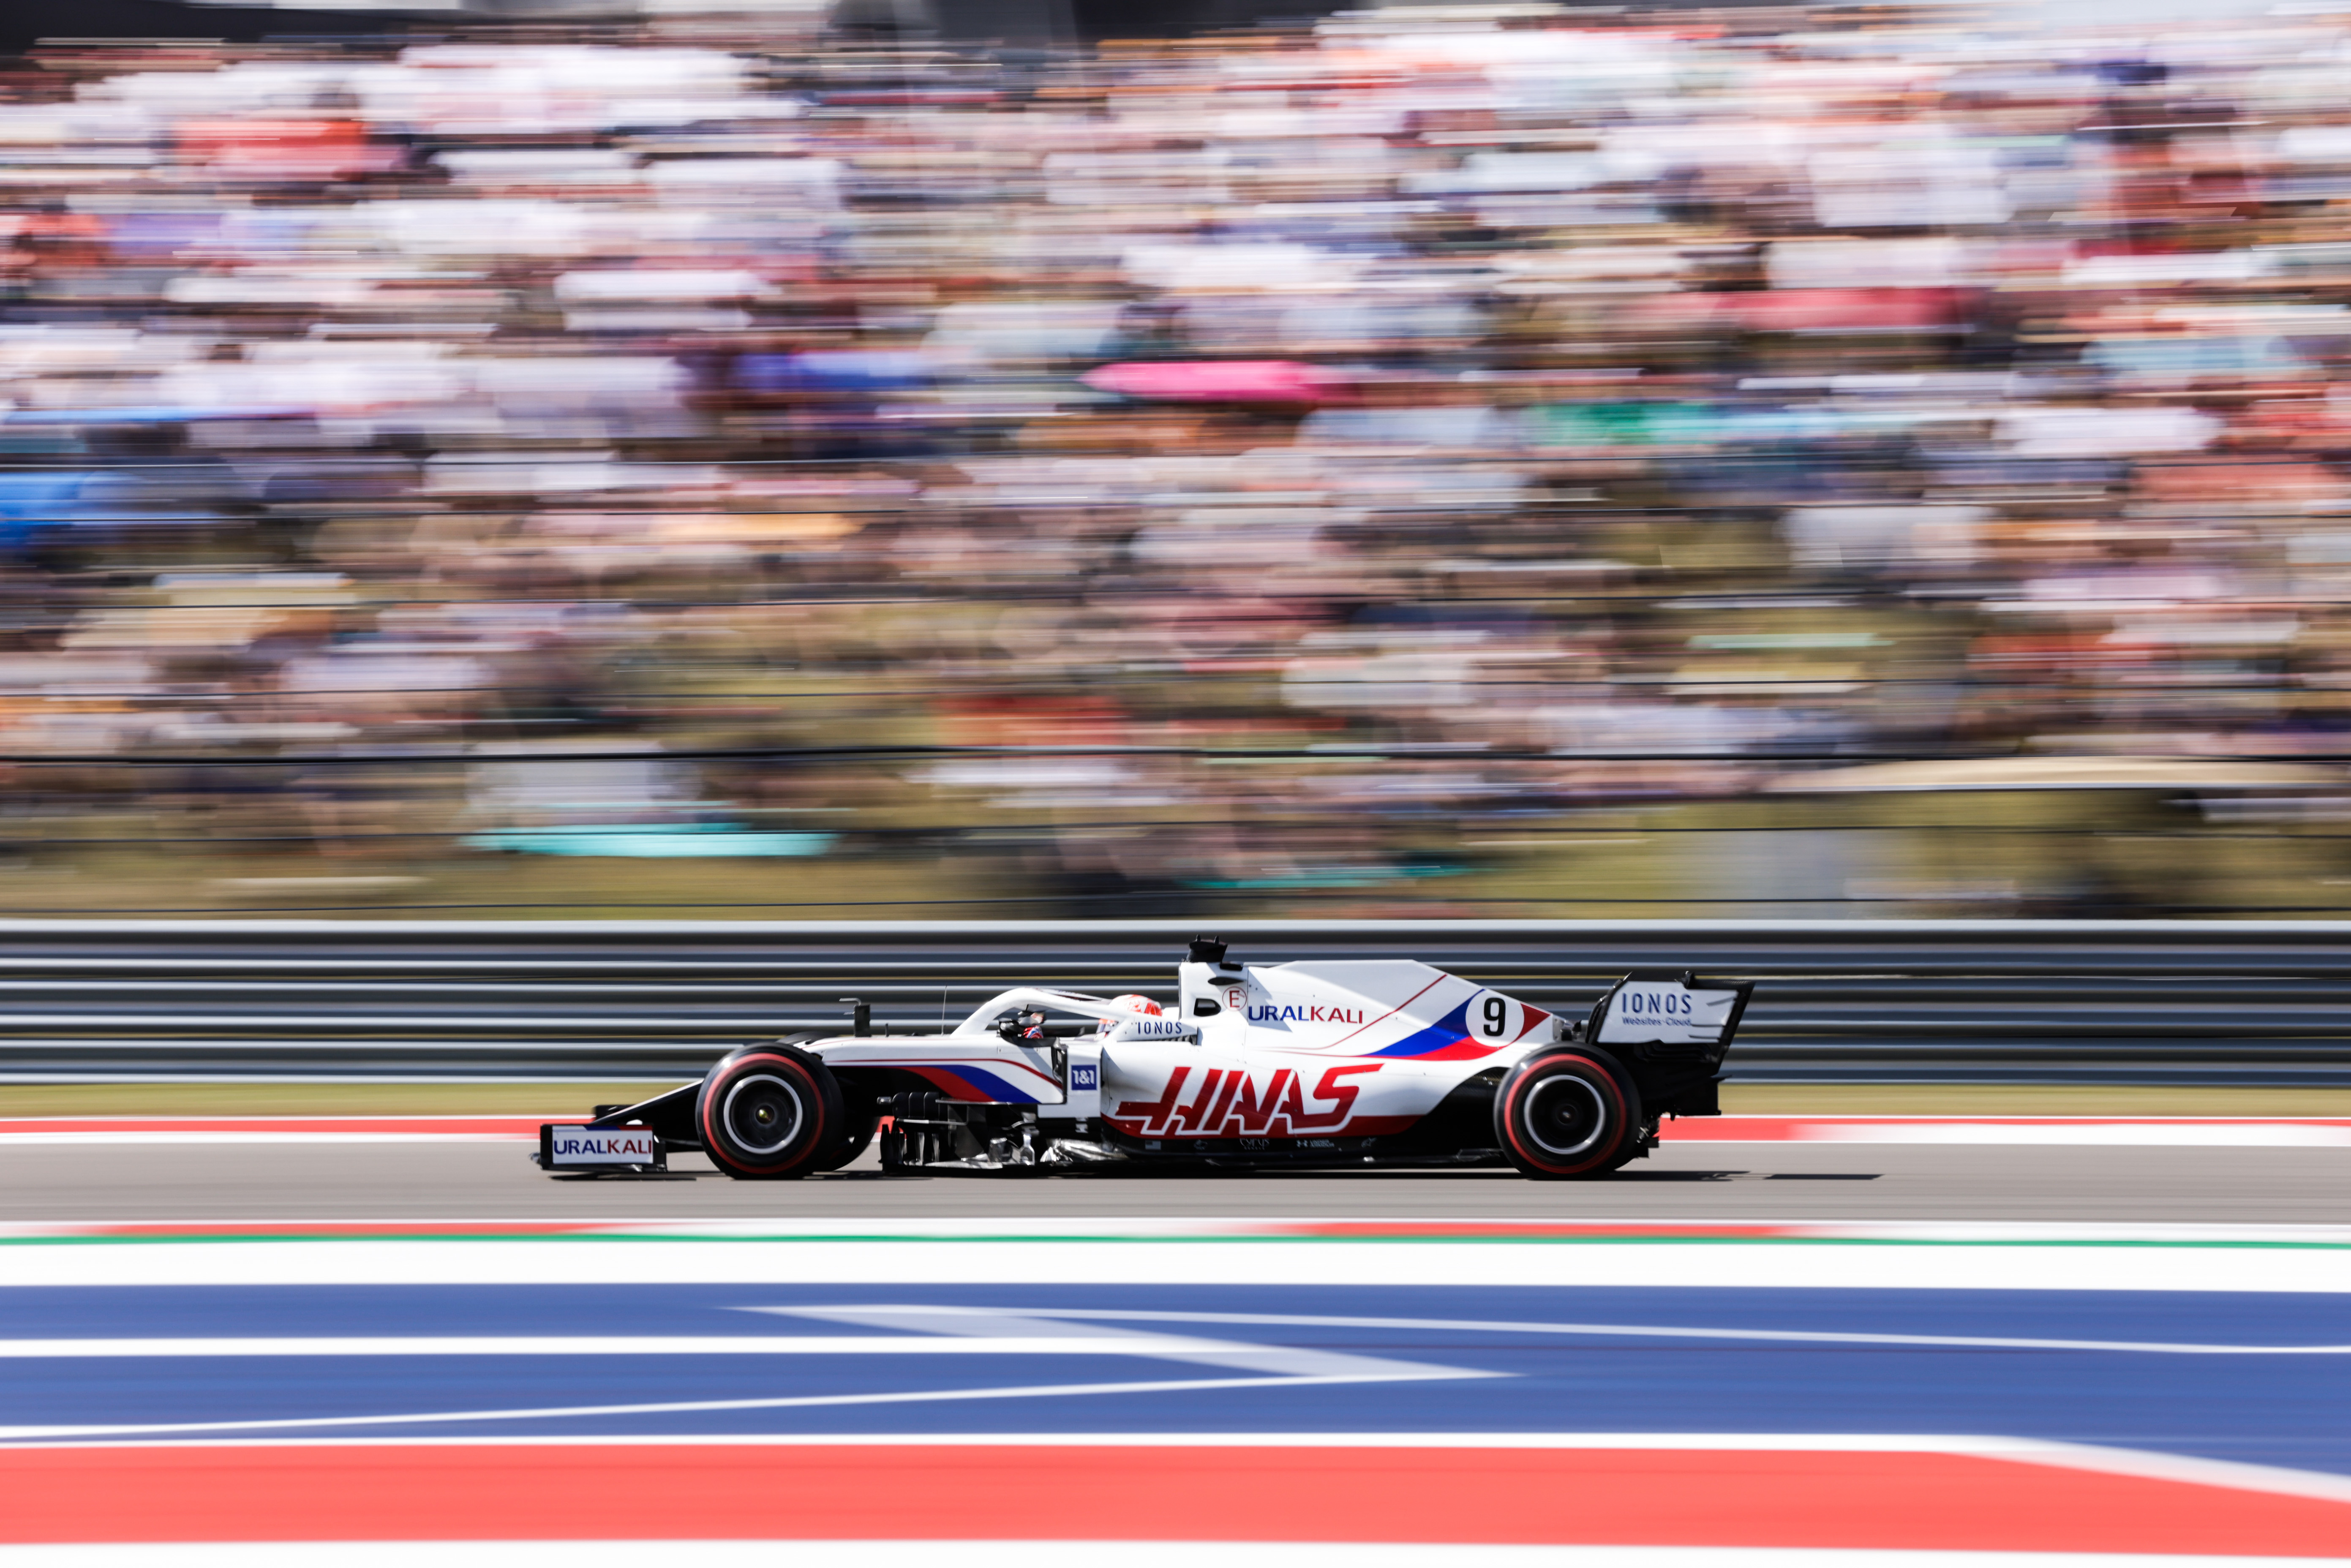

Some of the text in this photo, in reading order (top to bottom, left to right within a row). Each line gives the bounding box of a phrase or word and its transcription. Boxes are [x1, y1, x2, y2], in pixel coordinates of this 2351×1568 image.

[1229, 990, 1240, 1008] E
[1622, 993, 1692, 1014] IONOS
[1248, 1005, 1363, 1024] URALKALI
[1483, 997, 1506, 1037] 9
[1138, 1021, 1182, 1034] IONOS
[1072, 1070, 1095, 1085] 1&1
[1115, 1063, 1385, 1135] HAAS
[553, 1139, 652, 1154] URALKALI
